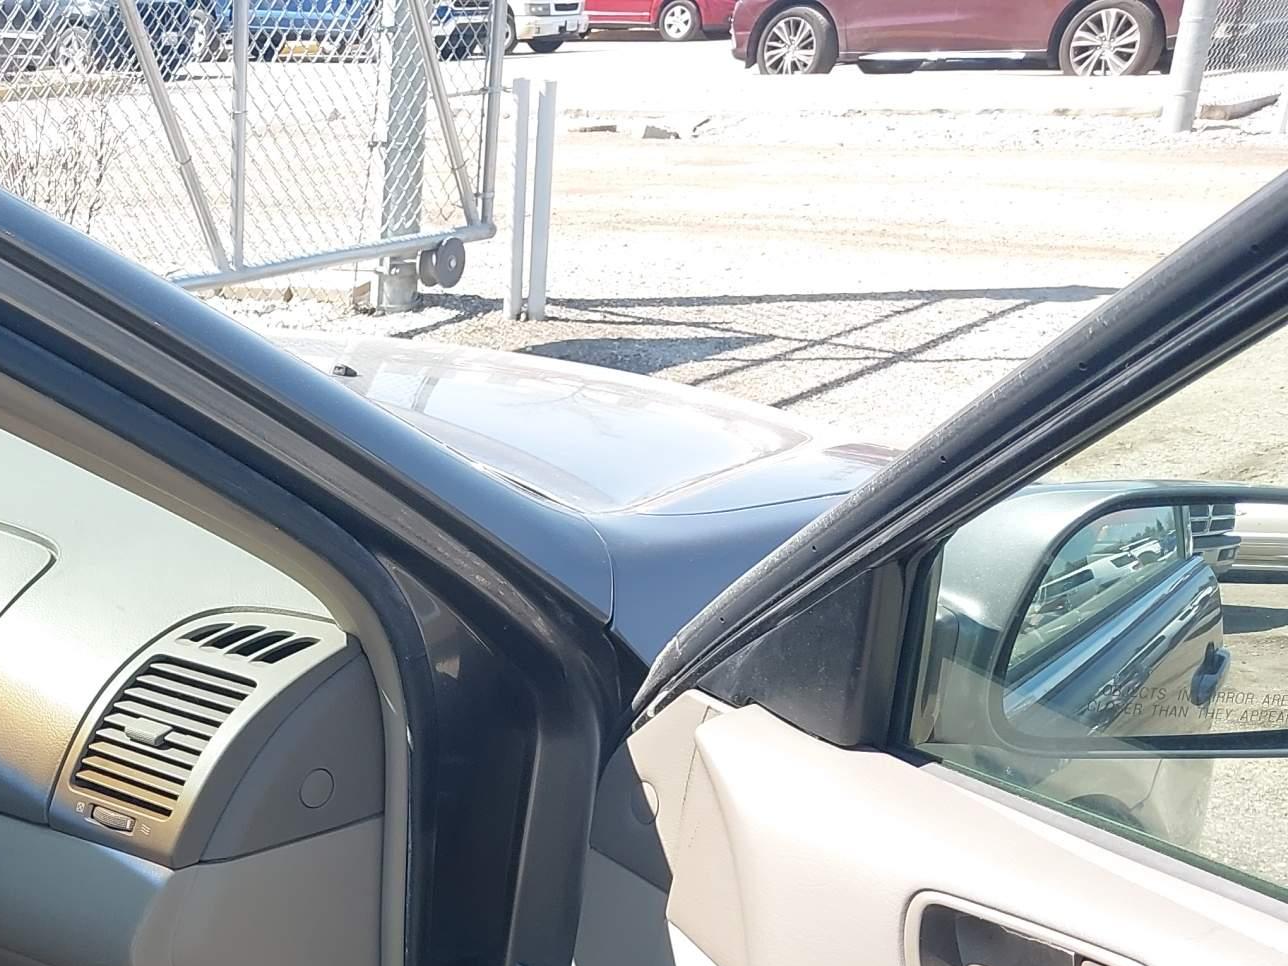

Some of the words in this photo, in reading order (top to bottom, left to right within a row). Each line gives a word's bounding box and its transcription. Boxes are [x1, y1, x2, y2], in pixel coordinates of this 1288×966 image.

[1200, 691, 1255, 705] IRROR
[1262, 693, 1288, 707] ARE
[1152, 704, 1190, 718] THAN
[1198, 706, 1234, 720] THEY
[1240, 709, 1288, 723] APPEA
